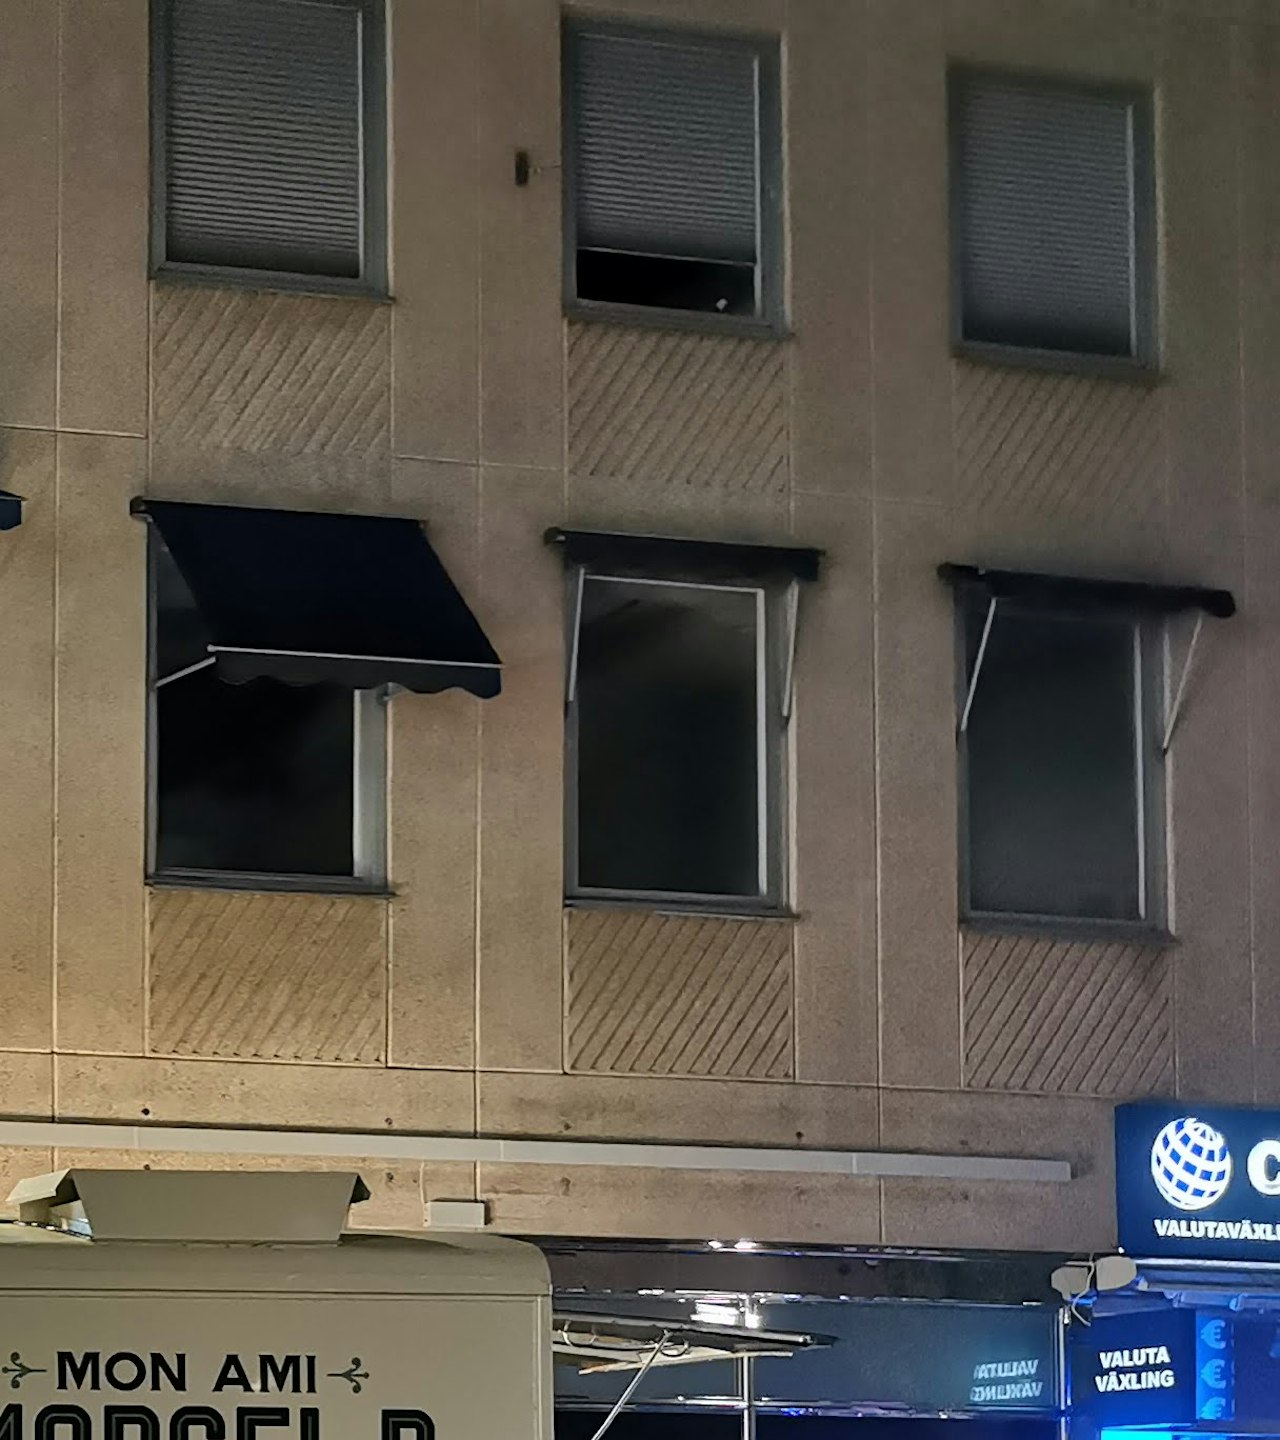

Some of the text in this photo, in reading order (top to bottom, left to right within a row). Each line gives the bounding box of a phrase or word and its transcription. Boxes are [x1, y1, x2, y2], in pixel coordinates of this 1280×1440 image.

[1099, 1346, 1171, 1369] VALUTA
[56, 1351, 317, 1393] MON AMI
[1095, 1370, 1175, 1393] VÄXLING
